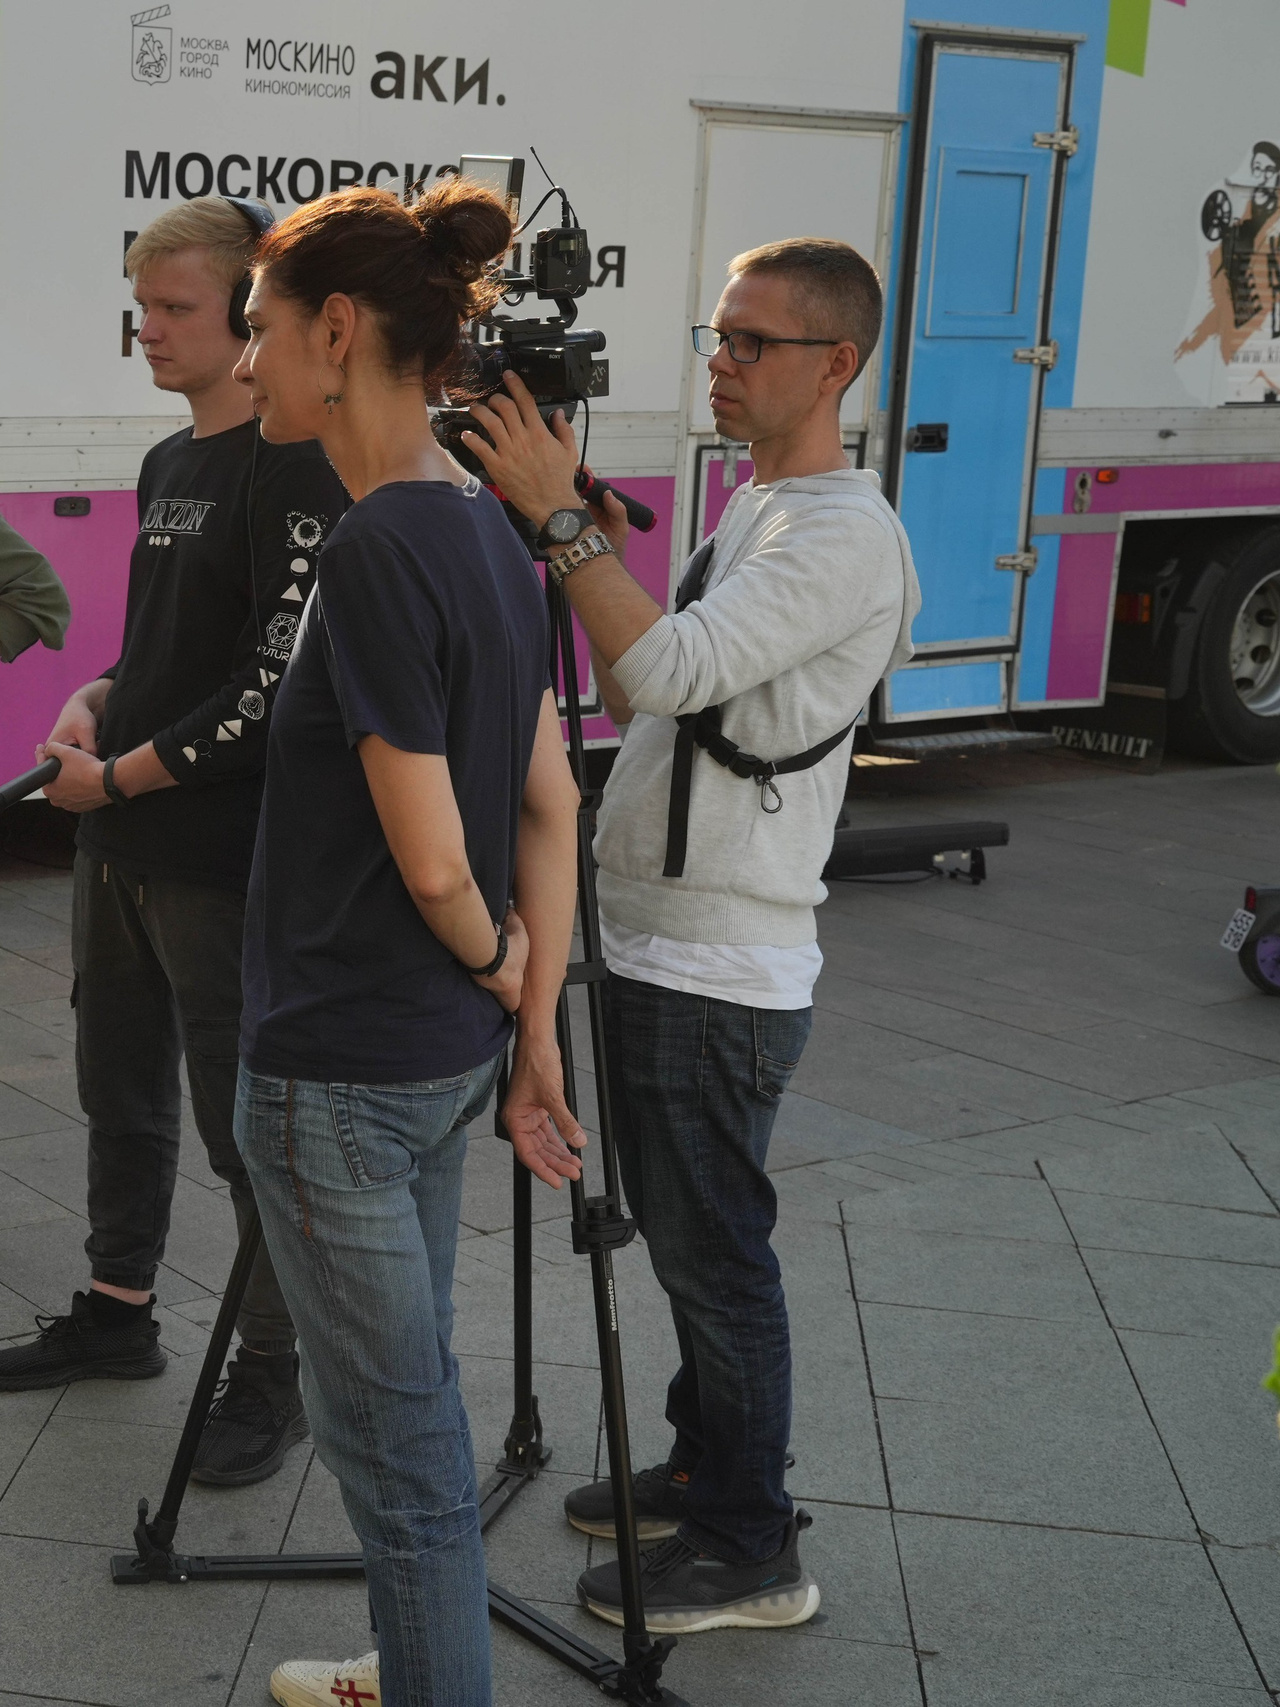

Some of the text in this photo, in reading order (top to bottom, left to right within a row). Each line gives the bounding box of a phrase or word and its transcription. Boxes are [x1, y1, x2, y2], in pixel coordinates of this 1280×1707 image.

[180, 37, 230, 51] МОСКВА
[180, 51, 219, 67] ГОРОД
[246, 37, 355, 76] МОСКИНО
[179, 66, 213, 80] КИНО
[245, 79, 351, 99] КИНОКОМИССИЯ
[256, 645, 291, 662] FUTUR
[1052, 725, 1153, 759] RENAULT
[607, 1278, 618, 1332] Manfrotto
